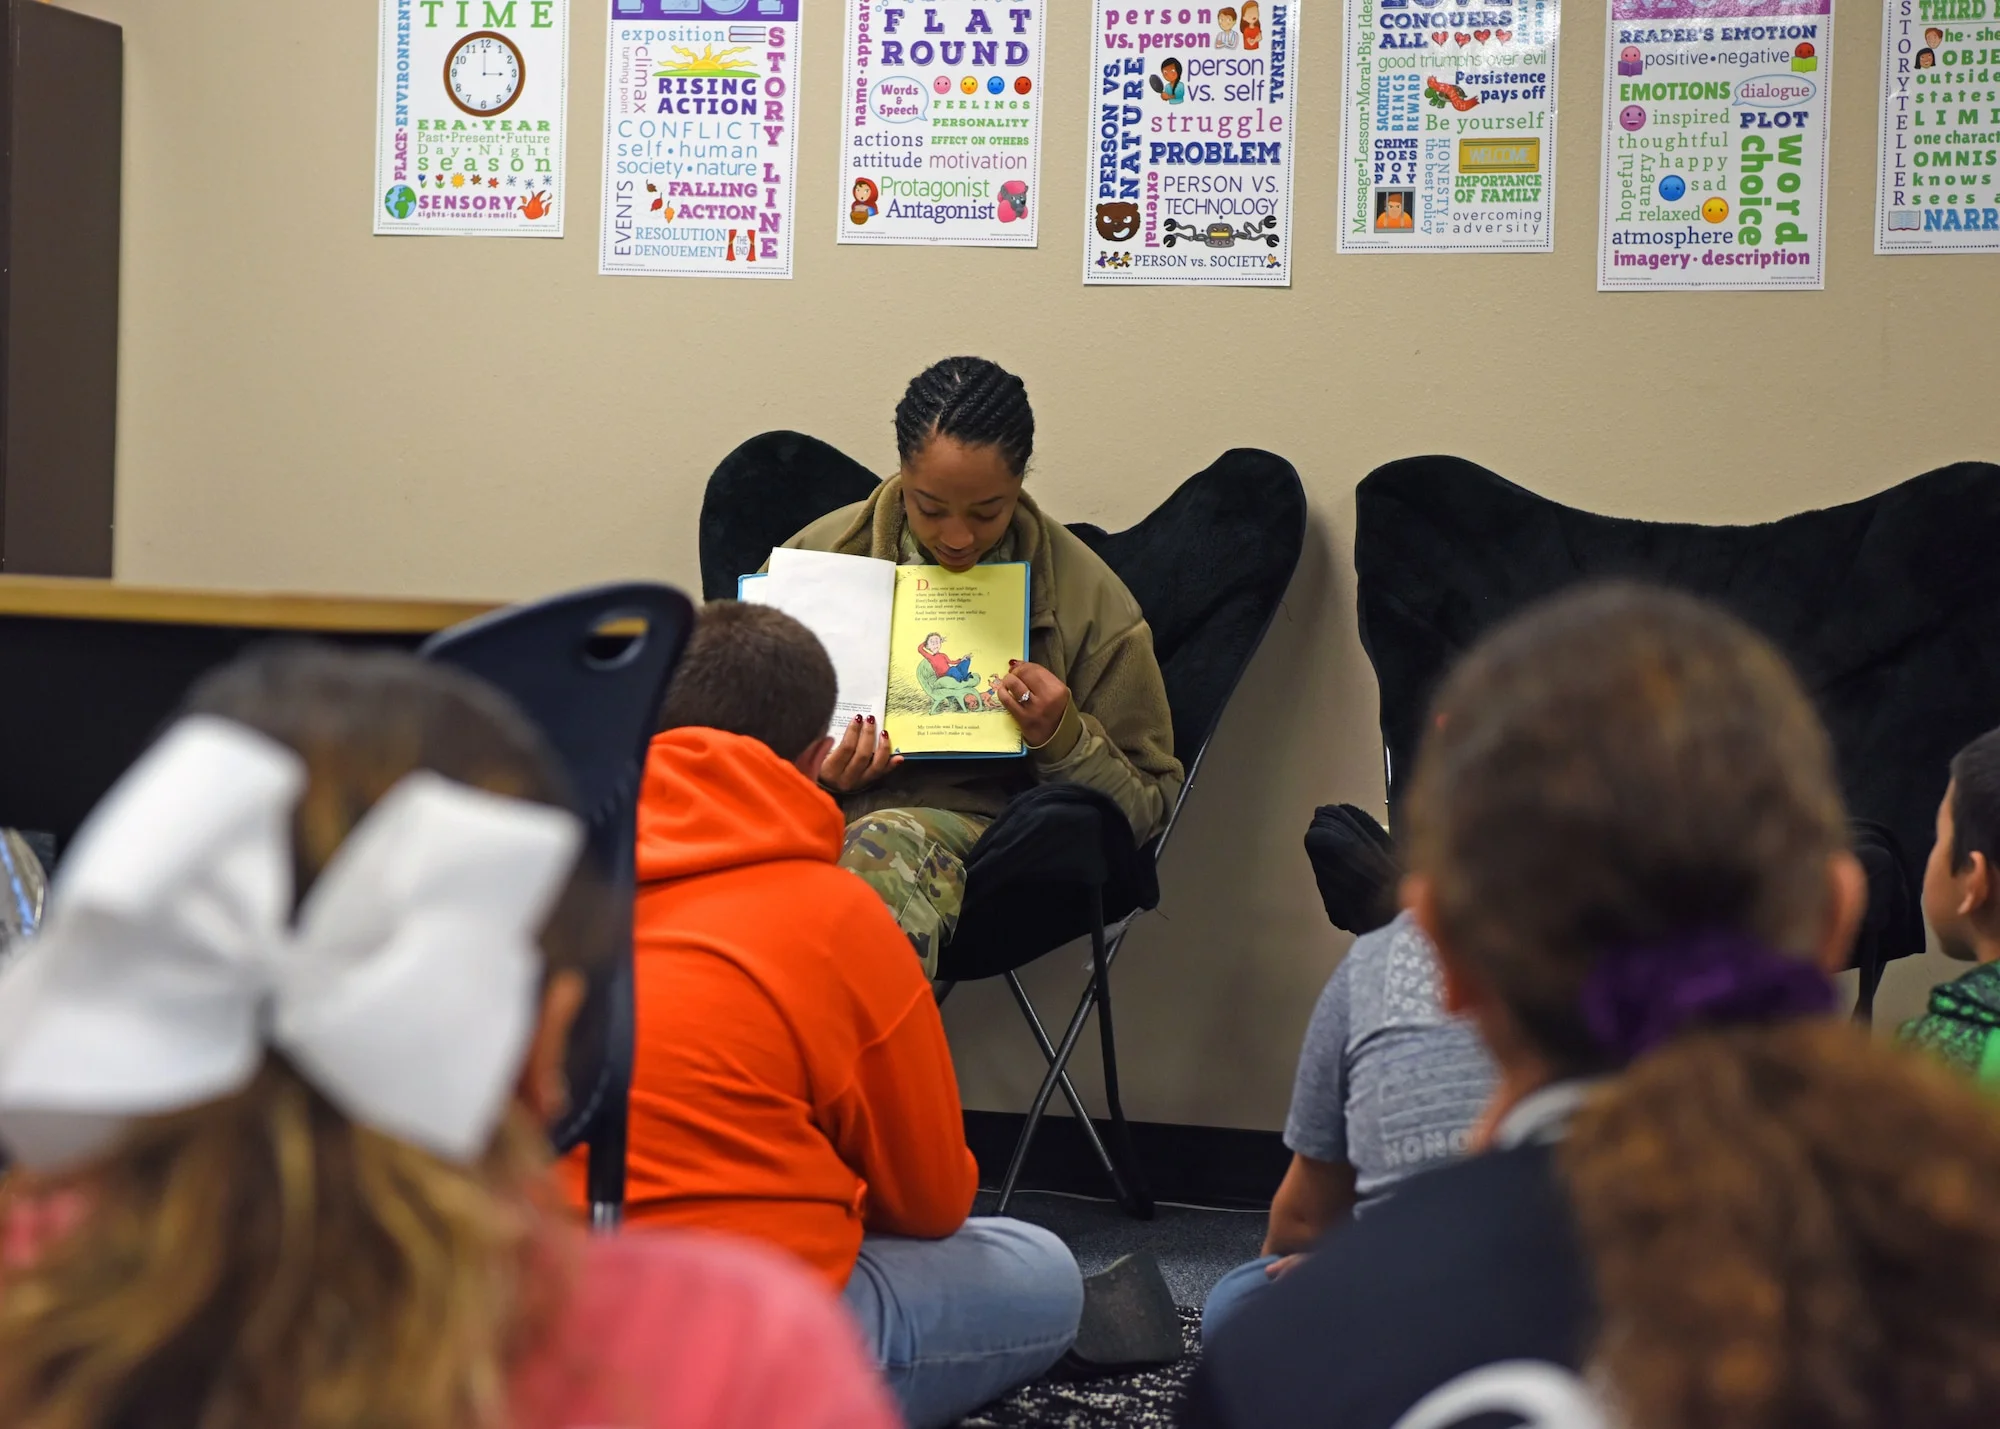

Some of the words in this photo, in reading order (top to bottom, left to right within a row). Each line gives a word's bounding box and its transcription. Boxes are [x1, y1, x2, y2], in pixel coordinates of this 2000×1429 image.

[420, 0, 553, 28] TIME
[1106, 8, 1211, 30] person
[1919, 0, 1986, 20] THIRD
[884, 9, 1031, 34] FLAT
[1379, 10, 1513, 29] CONQUERS
[622, 26, 725, 44] exposition
[1105, 32, 1133, 49] vs.
[1138, 32, 1210, 54] person
[1378, 33, 1428, 50] ALL
[1619, 28, 1714, 44] READER'S
[1720, 25, 1818, 40] EMOTION
[1945, 28, 1964, 42] he
[466, 44, 476, 54] 11
[480, 40, 491, 48] 12
[498, 45, 502, 54] 1
[881, 40, 1030, 66] ROUND
[1358, 32, 1376, 57] Big
[455, 56, 466, 64] 10
[506, 56, 512, 64] 2
[1269, 4, 1287, 104] INTERNAL
[1378, 54, 1416, 72] good
[1420, 52, 1482, 72] triumphs
[1486, 54, 1518, 66] over
[1523, 51, 1546, 66] evil
[1645, 50, 1708, 70] positive
[1718, 48, 1790, 68] negative
[451, 69, 458, 78] 9
[512, 69, 518, 78] 3
[620, 46, 630, 84] turning
[1188, 58, 1264, 82] person
[634, 46, 652, 114] climax
[1103, 58, 1122, 96] VS.
[1356, 62, 1372, 107] Moral
[1455, 71, 1546, 85] Persistence
[1916, 68, 2000, 84] outside
[455, 84, 462, 92] 8
[506, 84, 512, 93] 4
[658, 78, 756, 95] RISING
[764, 26, 786, 146] STORY
[881, 84, 918, 95] Words
[1188, 84, 1215, 102] vs.
[1224, 79, 1264, 102] self
[1481, 89, 1520, 104] pays
[1522, 86, 1546, 99] off
[1620, 81, 1731, 102] EMOTIONS
[1740, 84, 1810, 102] dialogue
[466, 94, 472, 104] 7
[480, 100, 487, 109] 6
[496, 95, 502, 104] 5
[620, 87, 628, 114] point
[856, 77, 868, 126] name
[933, 100, 1031, 110] FEELINGS
[1376, 76, 1390, 132] SACRIFICE
[1392, 74, 1406, 132] BRINGS
[1406, 74, 1420, 132] REWARD
[1916, 90, 1995, 104] states
[658, 98, 757, 115] ACTION
[879, 104, 918, 117] Speech
[417, 120, 466, 130] ERA
[485, 120, 550, 131] YEAR
[932, 118, 1030, 128] PERSONALITY
[1151, 108, 1283, 138] struggle
[1425, 114, 1450, 131] Be
[1456, 112, 1544, 134] yourself
[1652, 108, 1730, 128] inspired
[1740, 111, 1810, 129] PLOT
[618, 120, 761, 140] CONFLICT
[1120, 56, 1145, 200] NATURE
[418, 132, 444, 142] Past
[451, 132, 499, 144] Present
[506, 133, 550, 144] Future
[854, 130, 924, 147] actions
[931, 136, 968, 144] EFFECT
[971, 137, 986, 145] ON
[989, 137, 1030, 146] OTHERS
[1354, 112, 1370, 164] Lesson
[1374, 138, 1418, 149] CRIME
[1618, 132, 1728, 152] thoughtful
[1914, 133, 1941, 145] one
[394, 133, 408, 181] PLACE
[418, 144, 458, 158] Day
[479, 145, 550, 158] Night
[618, 141, 663, 156] self
[680, 142, 758, 158] human
[1100, 103, 1120, 199] PERSON
[1149, 142, 1282, 166] PROBLEM
[1374, 150, 1417, 161] DOES
[1426, 138, 1436, 160] the
[1470, 148, 1528, 162] WELCOME
[418, 157, 552, 172] season
[617, 158, 683, 178] society
[696, 160, 757, 176] nature
[853, 152, 922, 168] attitude
[929, 151, 1027, 169] motivation
[1374, 162, 1417, 173] NOT
[1660, 153, 1728, 172] happy
[1164, 176, 1242, 193] PERSON
[1252, 176, 1279, 194] VS.
[1374, 174, 1416, 184] PAY
[1424, 162, 1438, 192] best
[1438, 138, 1450, 220] HONESTY
[1454, 175, 1542, 188] IMPORTANCE
[1640, 153, 1656, 207] angry
[1691, 176, 1727, 190] sad
[1912, 172, 1992, 186] knows
[669, 182, 758, 198] FALLING
[881, 176, 990, 202] Protagonist
[1454, 189, 1475, 203] OF
[1482, 188, 1542, 202] FAMILY
[1616, 153, 1636, 222] hopeful
[1738, 135, 1774, 246] choice
[1774, 134, 1808, 245] word
[418, 195, 517, 210] SENSORY
[1164, 198, 1279, 216] TECHNOLOGY
[1352, 168, 1371, 234] Message
[1912, 194, 1976, 205] sees
[418, 210, 446, 218] sights
[450, 210, 483, 218] sounds
[614, 180, 634, 256] EVENTS
[677, 204, 757, 220] ACTION
[758, 163, 782, 258] LINE
[886, 199, 996, 224] Antagonist
[1144, 171, 1160, 248] external
[1421, 194, 1436, 235] policy
[1453, 210, 1542, 223] overcoming
[1638, 206, 1701, 222] relaxed
[636, 228, 726, 242] RESOLUTION
[1436, 222, 1448, 234] is
[1453, 222, 1539, 234] adversity
[736, 236, 748, 245] THE
[1612, 226, 1733, 249] atmosphere
[635, 244, 726, 258] DENOUEMENT
[736, 246, 748, 256] END
[1614, 250, 1691, 270] imagery
[1702, 249, 1810, 268] description
[1134, 254, 1188, 267] PERSON
[1190, 258, 1207, 268] vs.
[1210, 254, 1267, 268] SOCIETY
